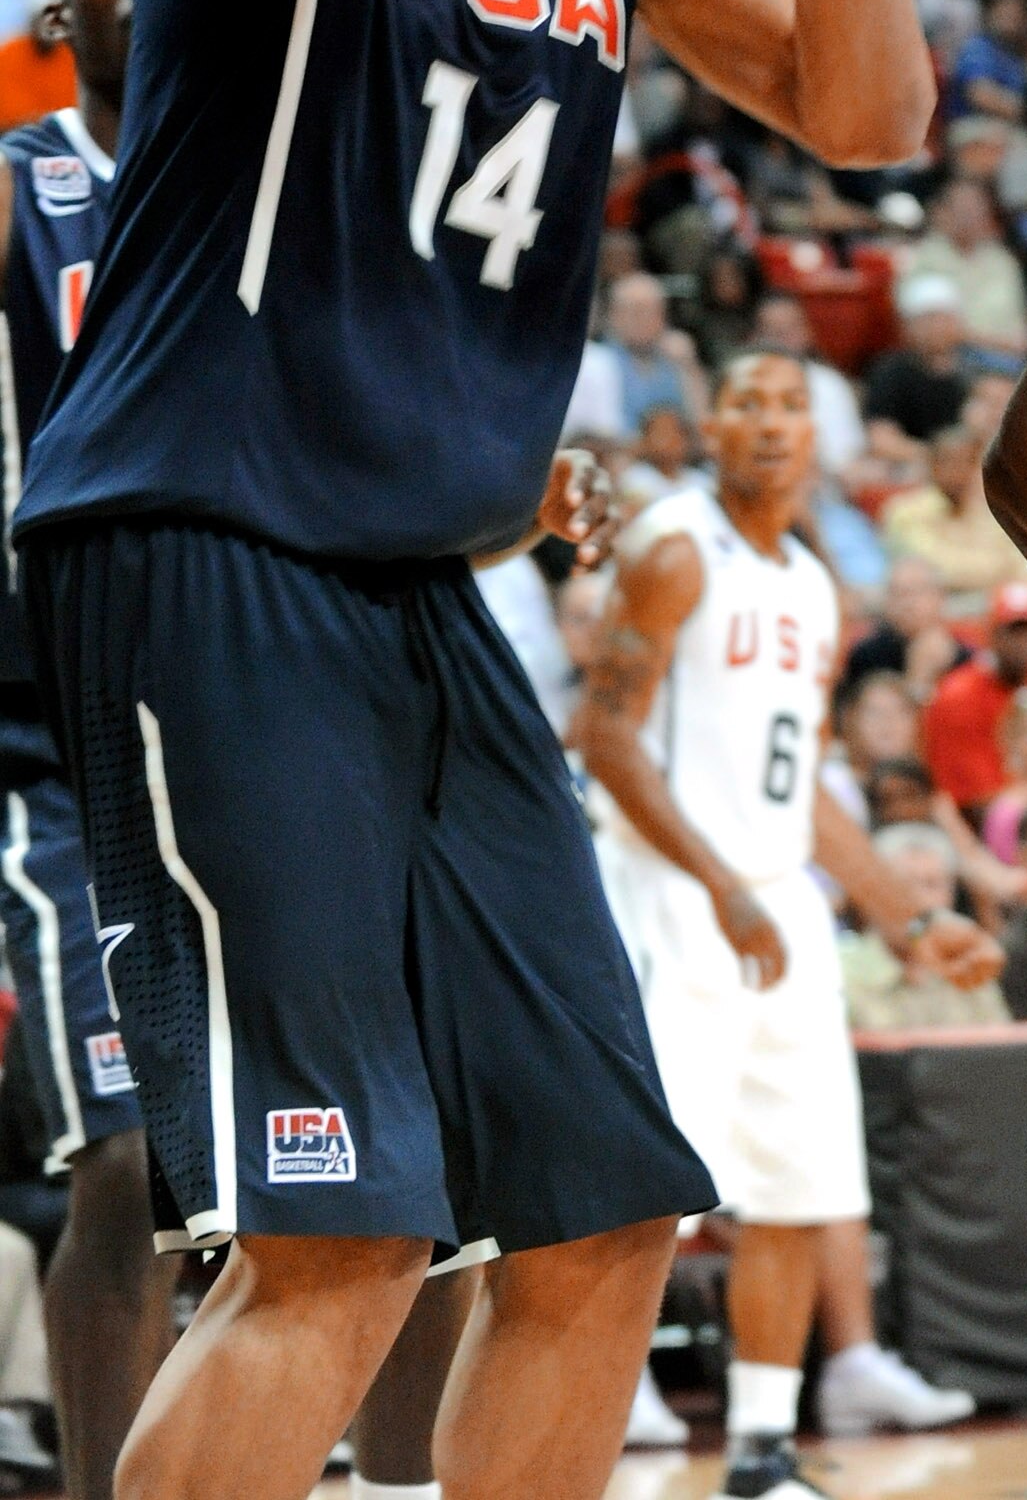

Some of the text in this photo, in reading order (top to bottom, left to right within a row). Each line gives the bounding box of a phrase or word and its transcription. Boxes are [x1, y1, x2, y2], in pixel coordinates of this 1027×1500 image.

[409, 60, 560, 290] 14
[763, 711, 801, 803] 6
[274, 1114, 348, 1154] USA
